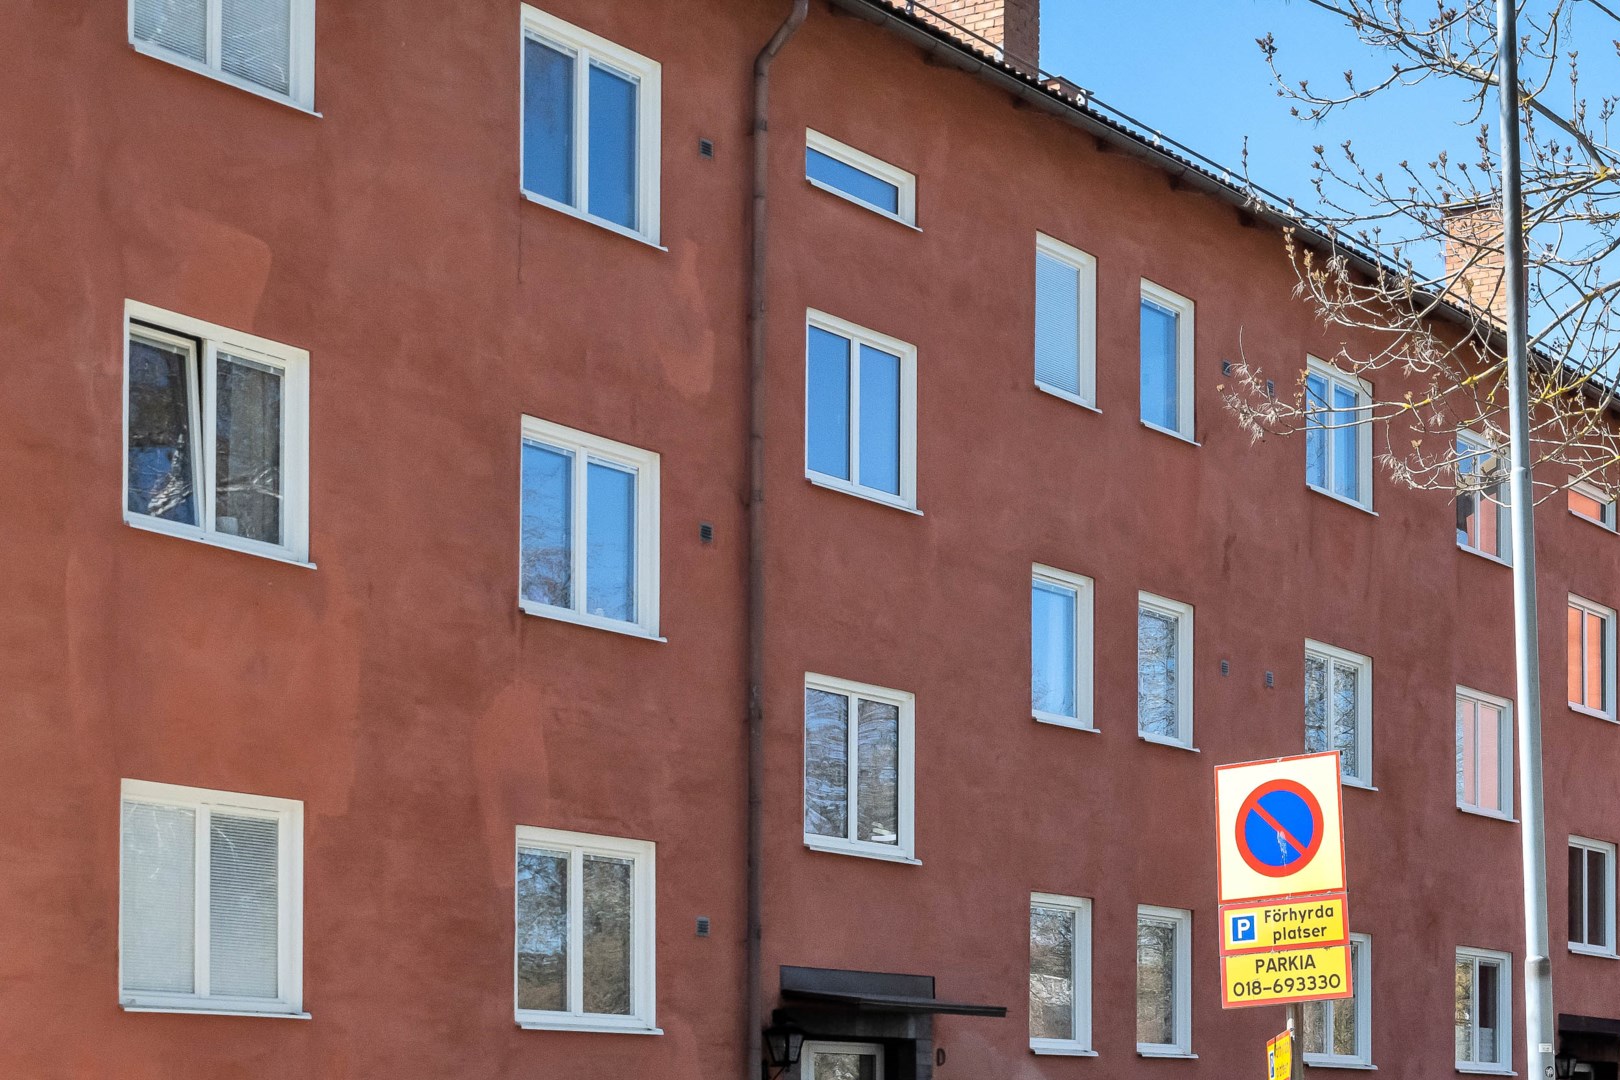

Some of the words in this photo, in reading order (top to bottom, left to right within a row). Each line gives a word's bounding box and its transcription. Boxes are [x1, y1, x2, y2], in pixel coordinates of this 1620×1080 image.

[1264, 905, 1334, 923] Förhyrda
[1237, 918, 1251, 939] P
[1273, 926, 1327, 944] platser
[1255, 954, 1316, 974] PARKIA
[1233, 973, 1341, 997] 018-693330
[936, 1047, 946, 1066] D
